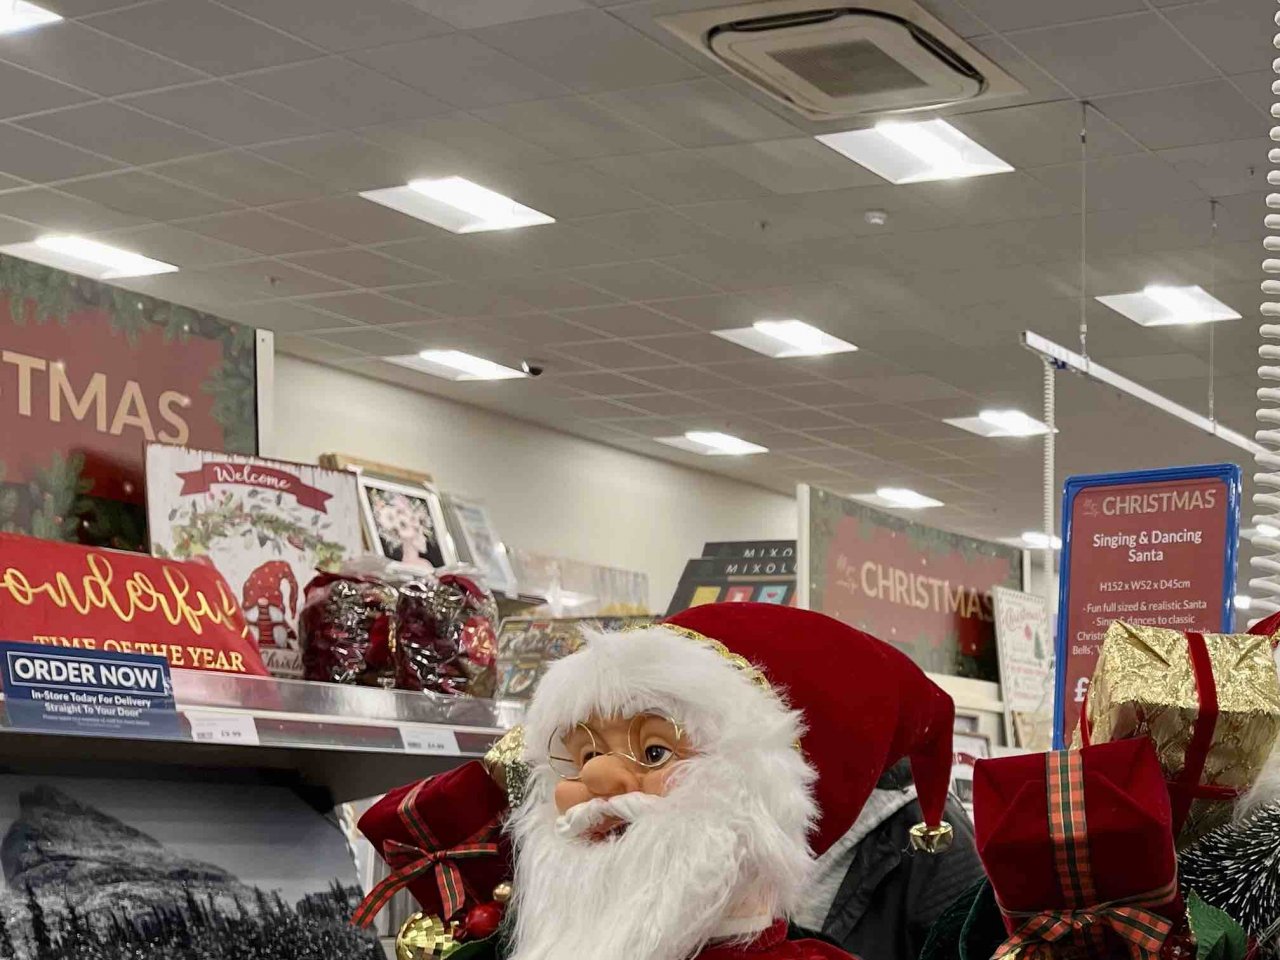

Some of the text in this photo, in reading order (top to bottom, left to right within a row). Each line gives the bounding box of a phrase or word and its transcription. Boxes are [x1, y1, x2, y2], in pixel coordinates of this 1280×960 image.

[0, 350, 192, 444] TMAS
[213, 465, 292, 489] Welcome
[1103, 489, 1216, 515] CHRISTMAS
[1093, 529, 1202, 548] Singing & Dancing
[1128, 549, 1163, 562] Santa
[0, 553, 240, 635] onderful
[861, 561, 995, 621] CHRISTMAS
[1100, 582, 1123, 591] H152
[1131, 581, 1152, 590] W52
[1160, 579, 1190, 589] D45cm
[1087, 603, 1102, 613] Fun
[1103, 602, 1117, 612] full
[1117, 602, 1139, 611] sized
[1140, 602, 1147, 611] &
[1148, 600, 1181, 610] realistic
[1183, 600, 1207, 609] Santa
[1127, 616, 1158, 625] dances
[1158, 616, 1168, 624] to
[1169, 615, 1196, 624] classic
[135, 643, 184, 665] THE
[187, 646, 246, 672] YEAR
[14, 657, 158, 689] ORDER NOW
[31, 689, 151, 709] In-Store Today For Delivery
[45, 702, 82, 715] Straight
[84, 705, 95, 714] To
[97, 706, 116, 716] Your
